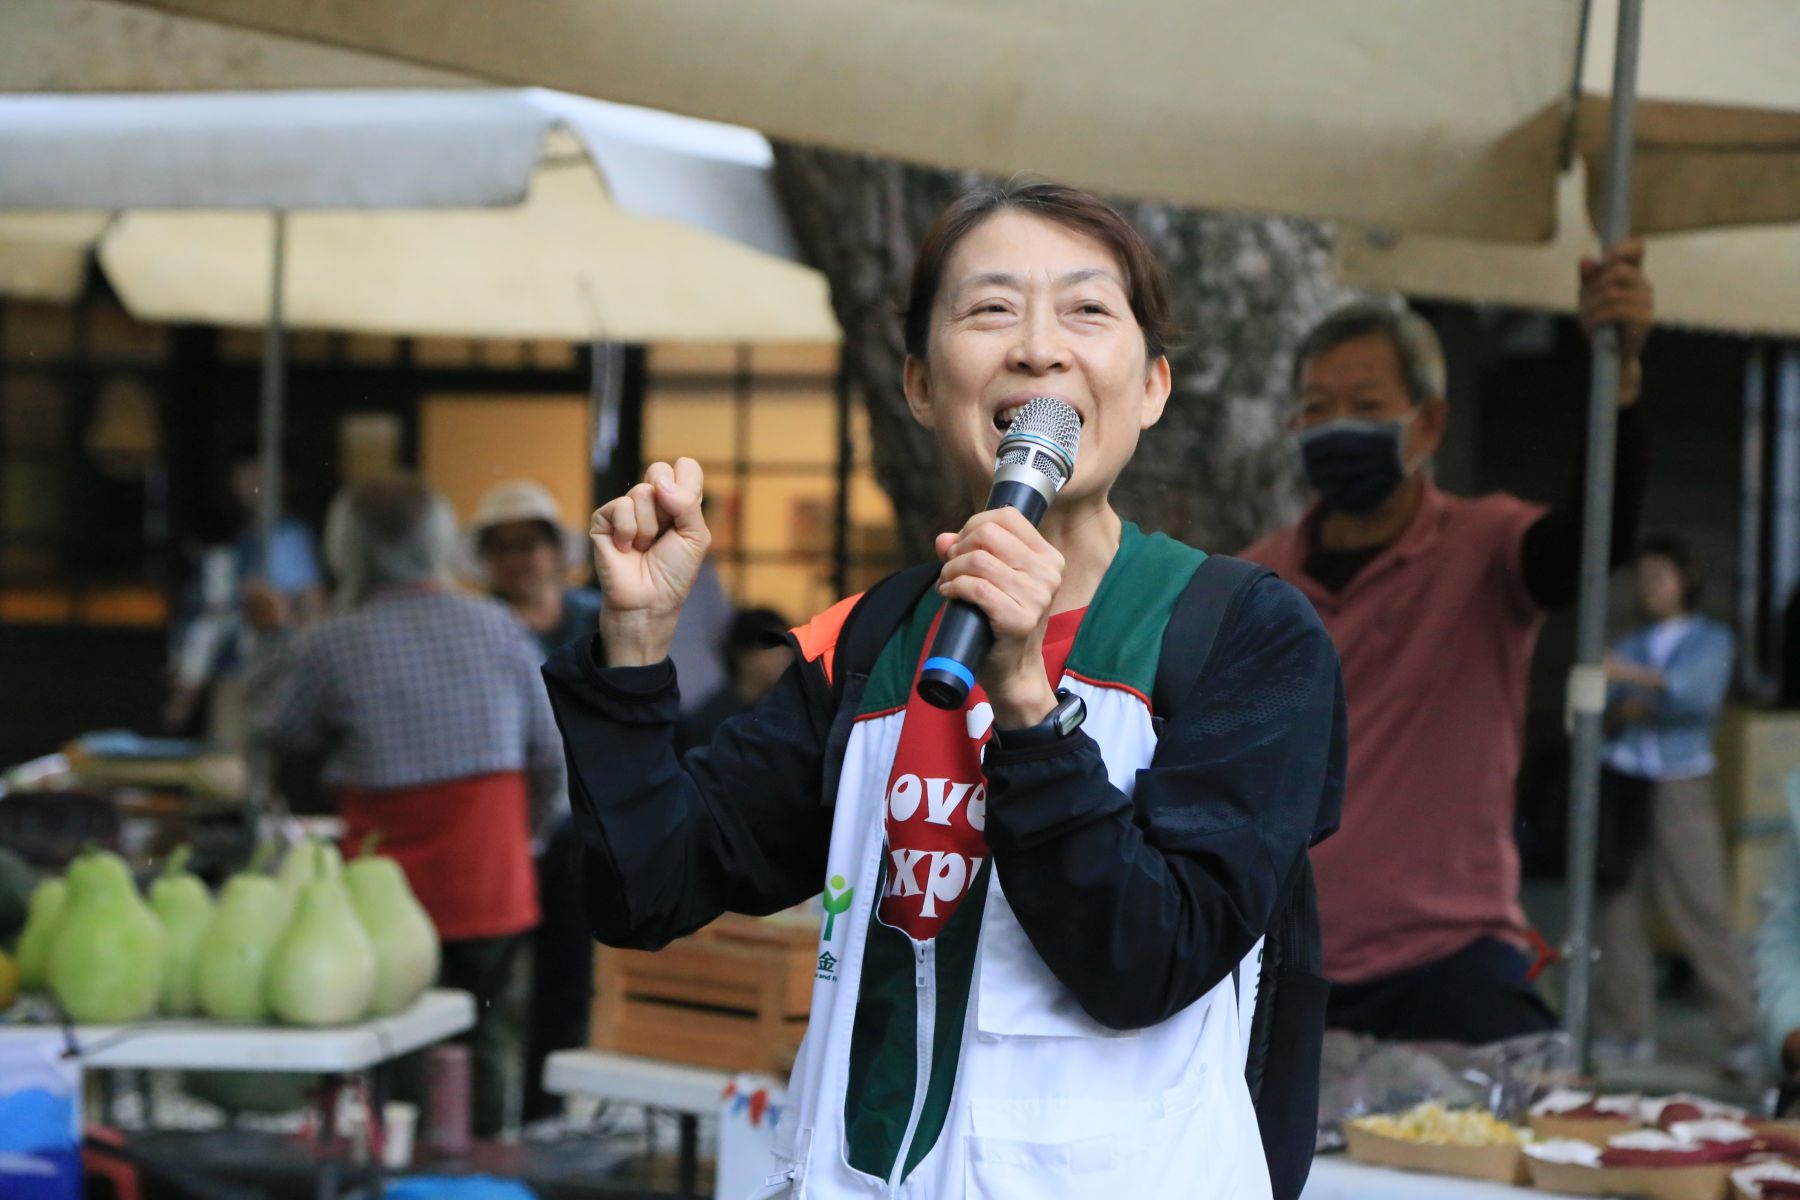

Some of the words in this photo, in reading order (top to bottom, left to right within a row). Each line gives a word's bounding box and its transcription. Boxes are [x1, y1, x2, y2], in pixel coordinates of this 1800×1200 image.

[884, 773, 986, 832] ove
[884, 848, 984, 918] xp
[817, 951, 837, 973] 金
